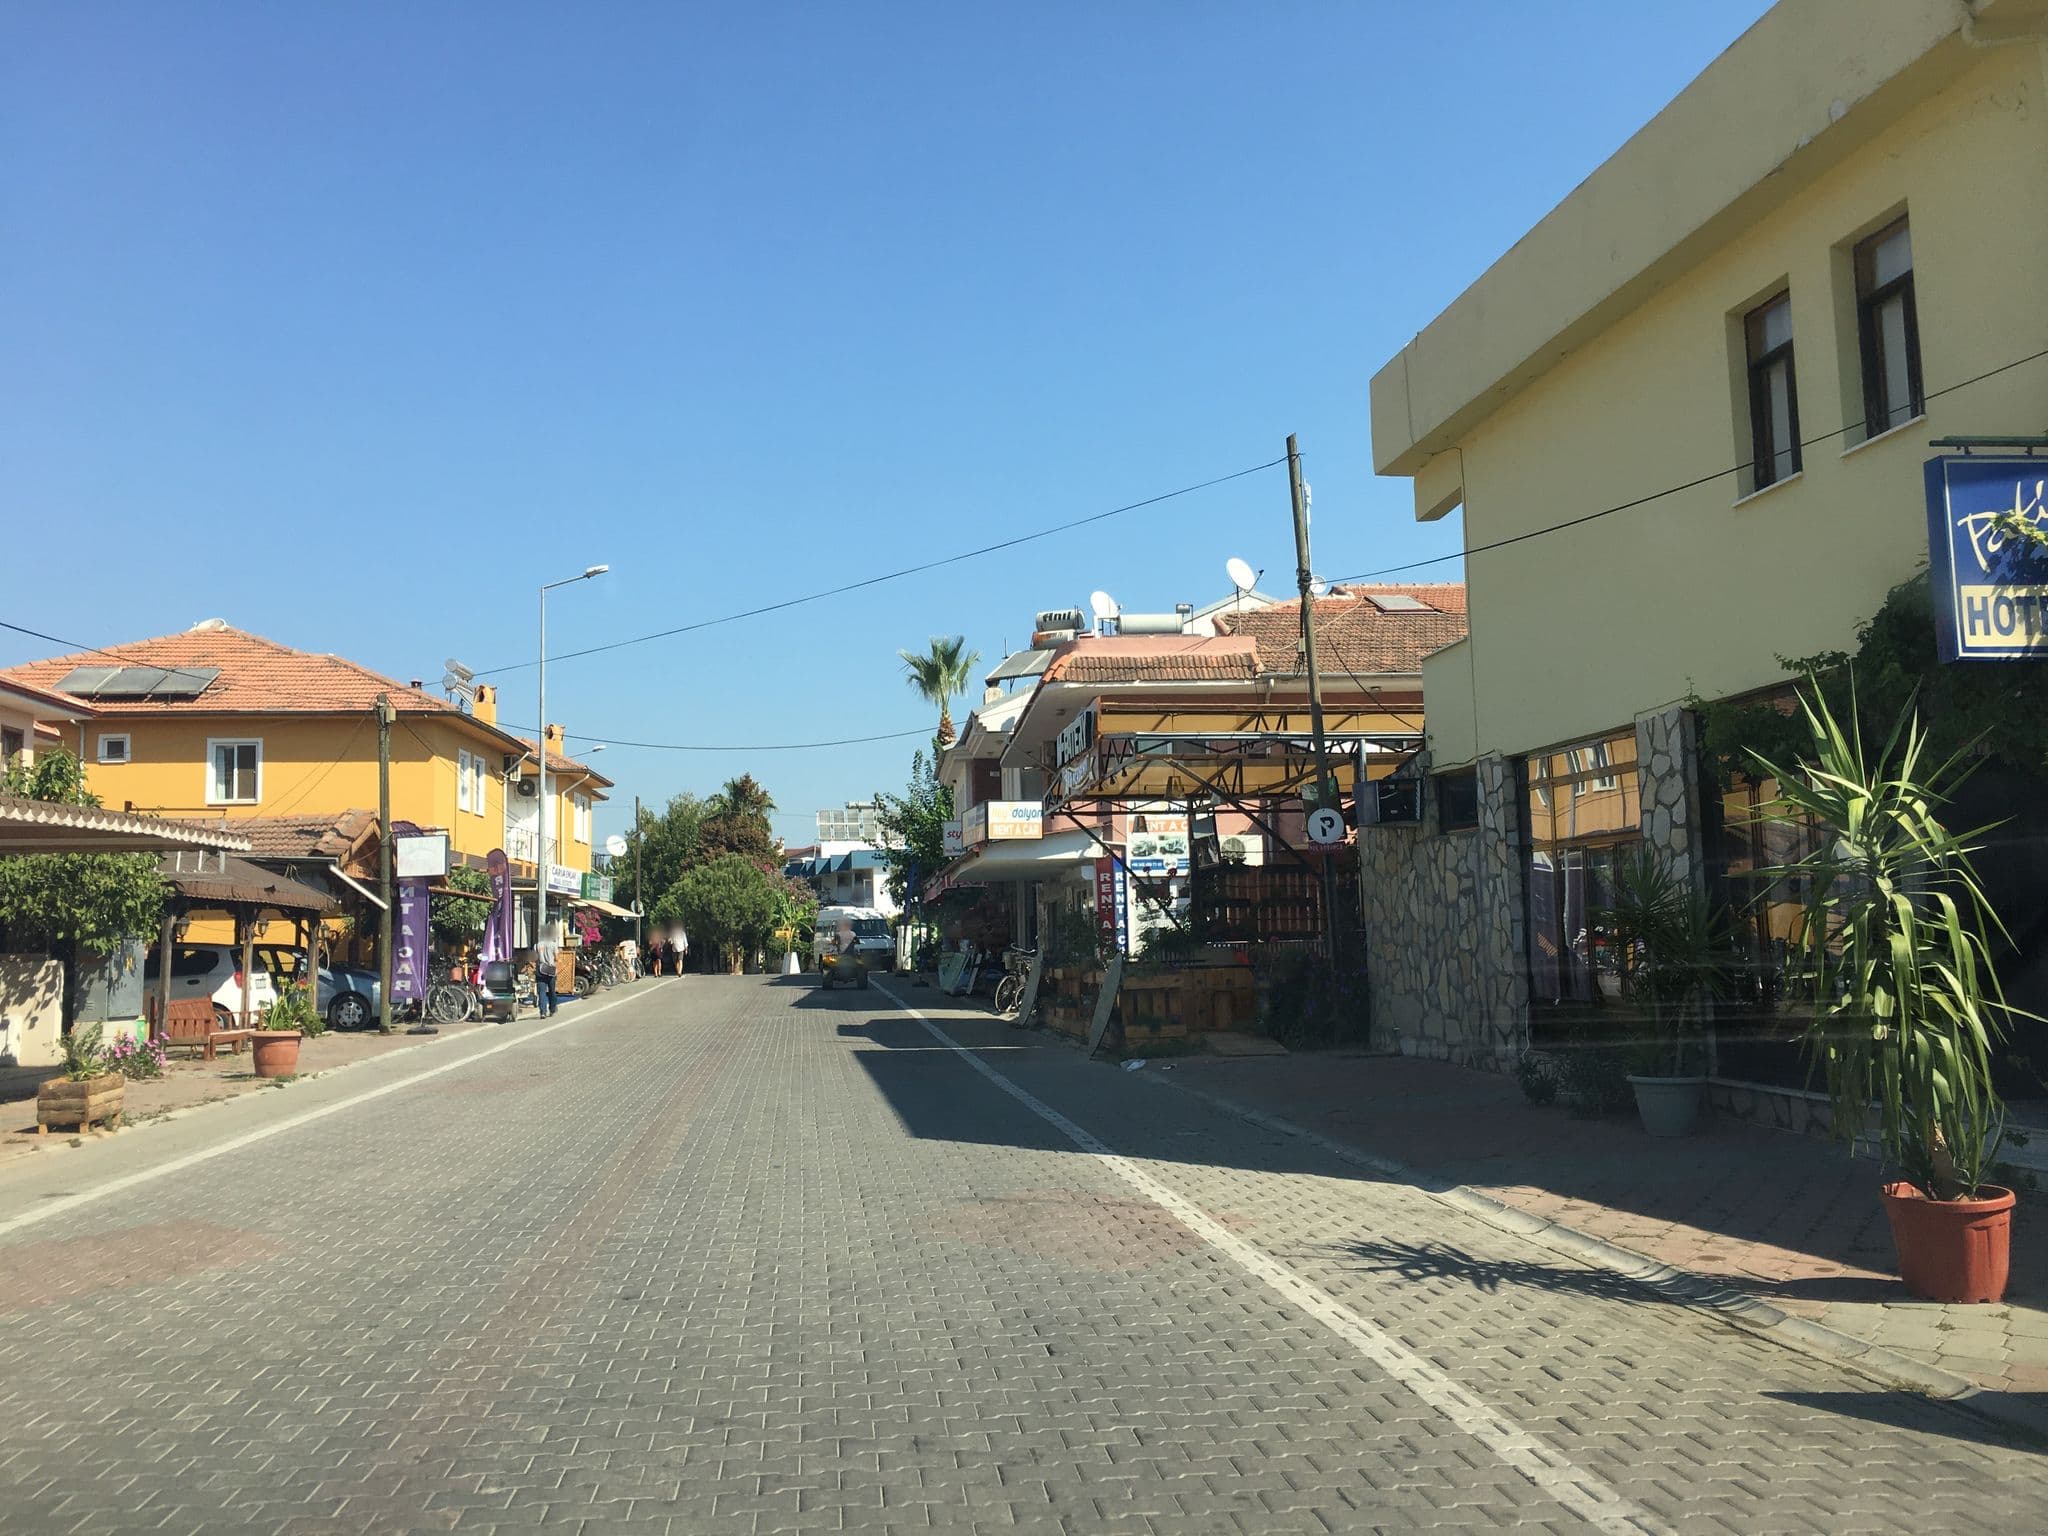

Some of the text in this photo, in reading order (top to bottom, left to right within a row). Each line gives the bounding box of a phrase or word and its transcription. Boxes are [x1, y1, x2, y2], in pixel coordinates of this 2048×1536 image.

[946, 830, 962, 840] sty
[1320, 816, 1335, 837] P
[1100, 872, 1113, 914] RENT
[1115, 871, 1125, 914] RENT
[1116, 919, 1126, 929] A
